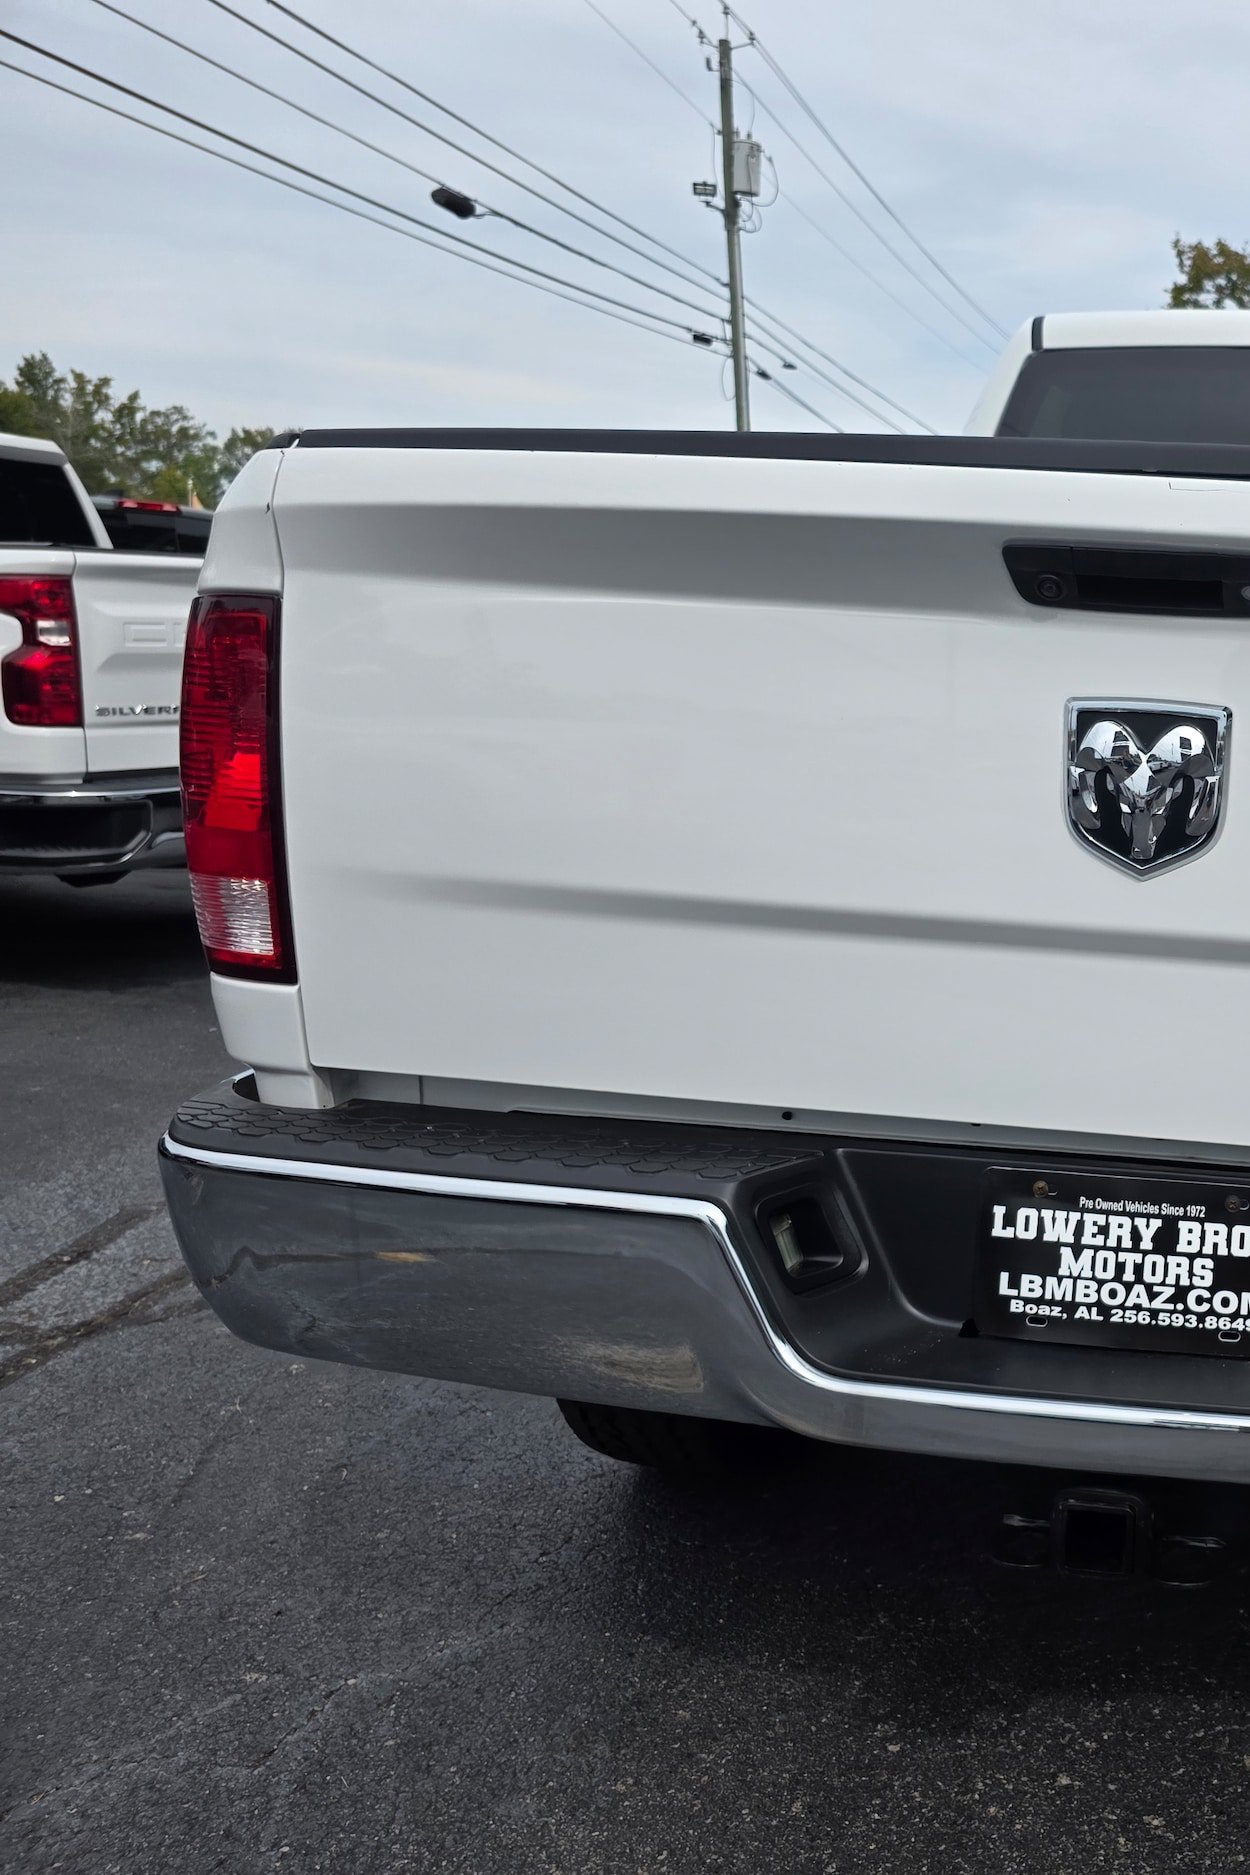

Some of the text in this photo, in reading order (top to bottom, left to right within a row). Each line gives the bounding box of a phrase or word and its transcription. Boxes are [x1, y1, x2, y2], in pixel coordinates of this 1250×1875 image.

[1079, 1196, 1206, 1218] Pre Owned Vehicles Since 1972
[991, 1205, 1162, 1250] LOWERY
[1058, 1246, 1215, 1288] MOTORS
[1009, 1299, 1068, 1320] Boaz,
[1075, 1305, 1104, 1321] AL
